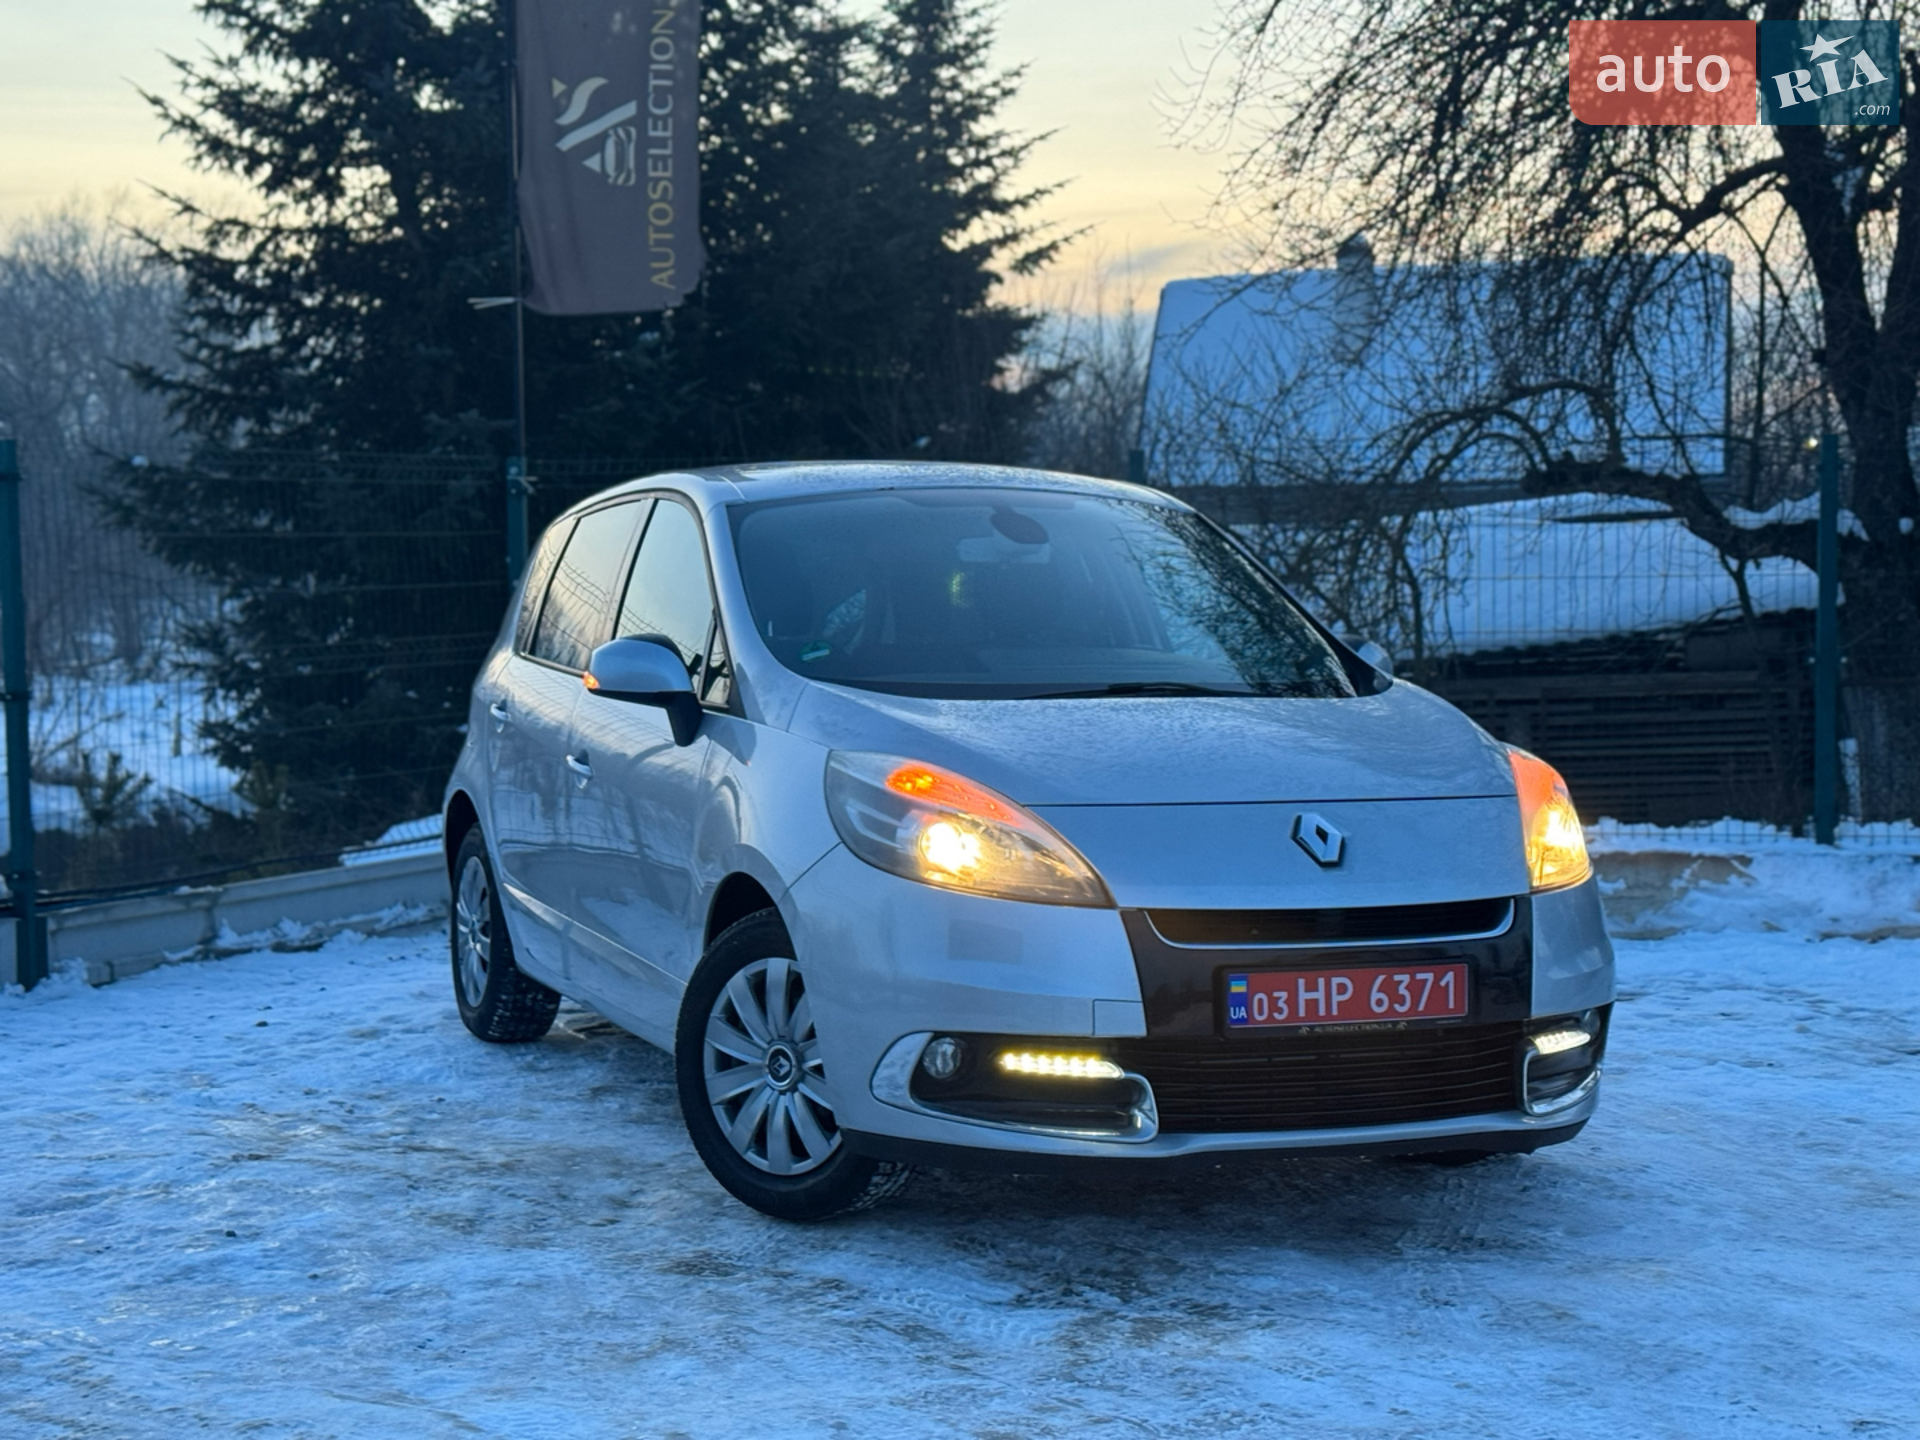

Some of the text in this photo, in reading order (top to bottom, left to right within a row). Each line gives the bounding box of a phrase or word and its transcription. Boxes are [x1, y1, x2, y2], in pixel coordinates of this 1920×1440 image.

[1252, 971, 1455, 1021] 03 HP 6371
[1230, 1006, 1247, 1019] UA
